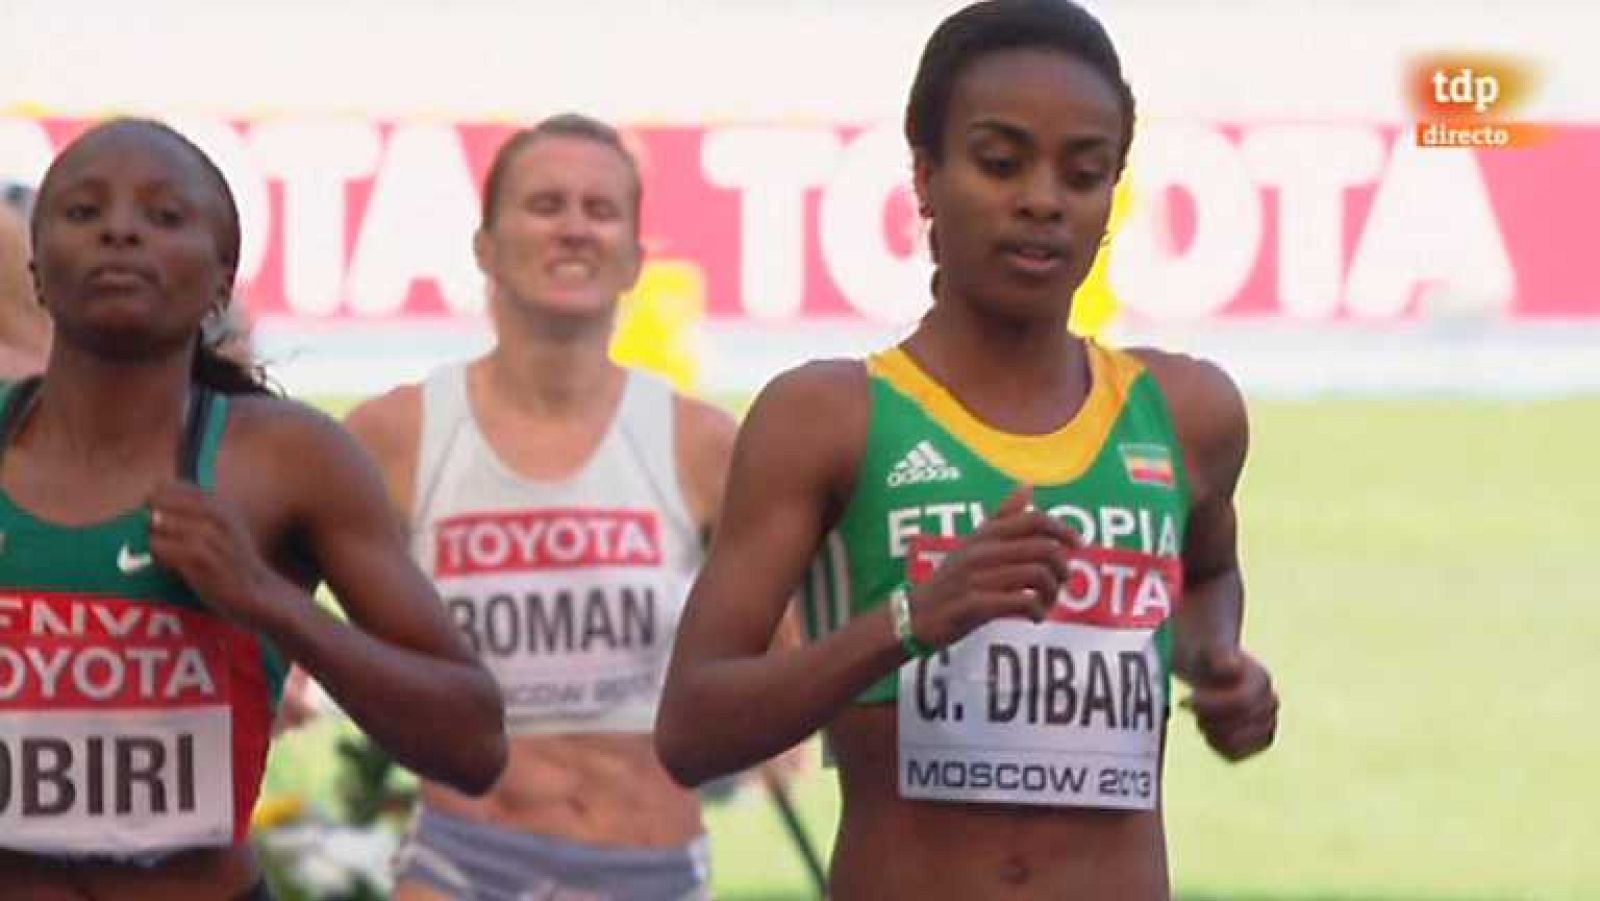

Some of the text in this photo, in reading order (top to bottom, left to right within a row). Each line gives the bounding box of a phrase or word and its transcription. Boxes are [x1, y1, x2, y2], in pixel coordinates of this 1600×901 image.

[700, 122, 1518, 320] TOOTA
[438, 517, 654, 569] TOYOTA
[887, 501, 1181, 558] ETOPIA
[915, 648, 964, 722] G.
[0, 734, 194, 817] BIRI
[906, 759, 1088, 793] MOSCOW
